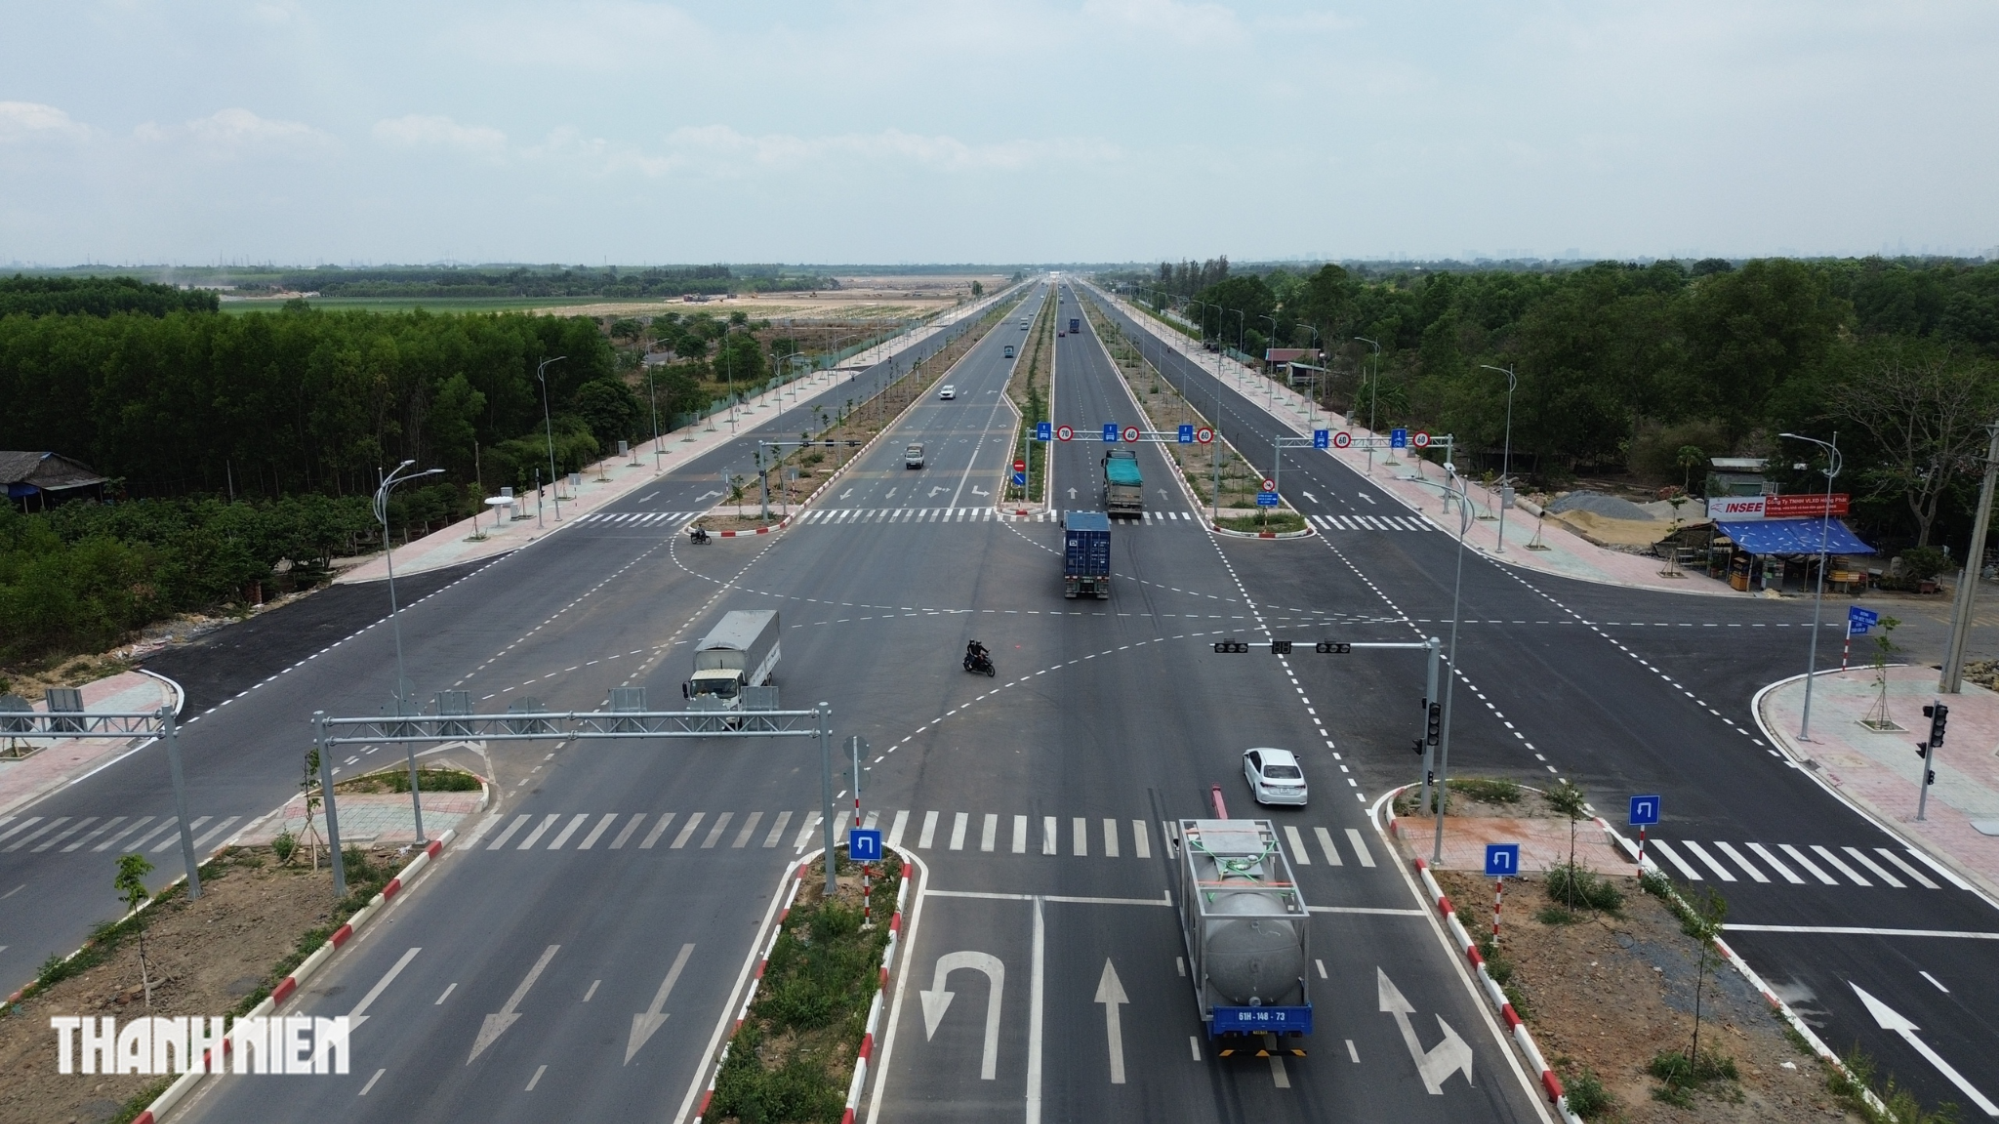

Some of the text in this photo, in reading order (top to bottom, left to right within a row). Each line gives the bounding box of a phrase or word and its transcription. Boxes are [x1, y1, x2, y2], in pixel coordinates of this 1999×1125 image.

[1201, 431, 1209, 439] 60
[1338, 436, 1346, 444] 60
[1416, 436, 1425, 444] 60
[1725, 502, 1763, 513] INSEE
